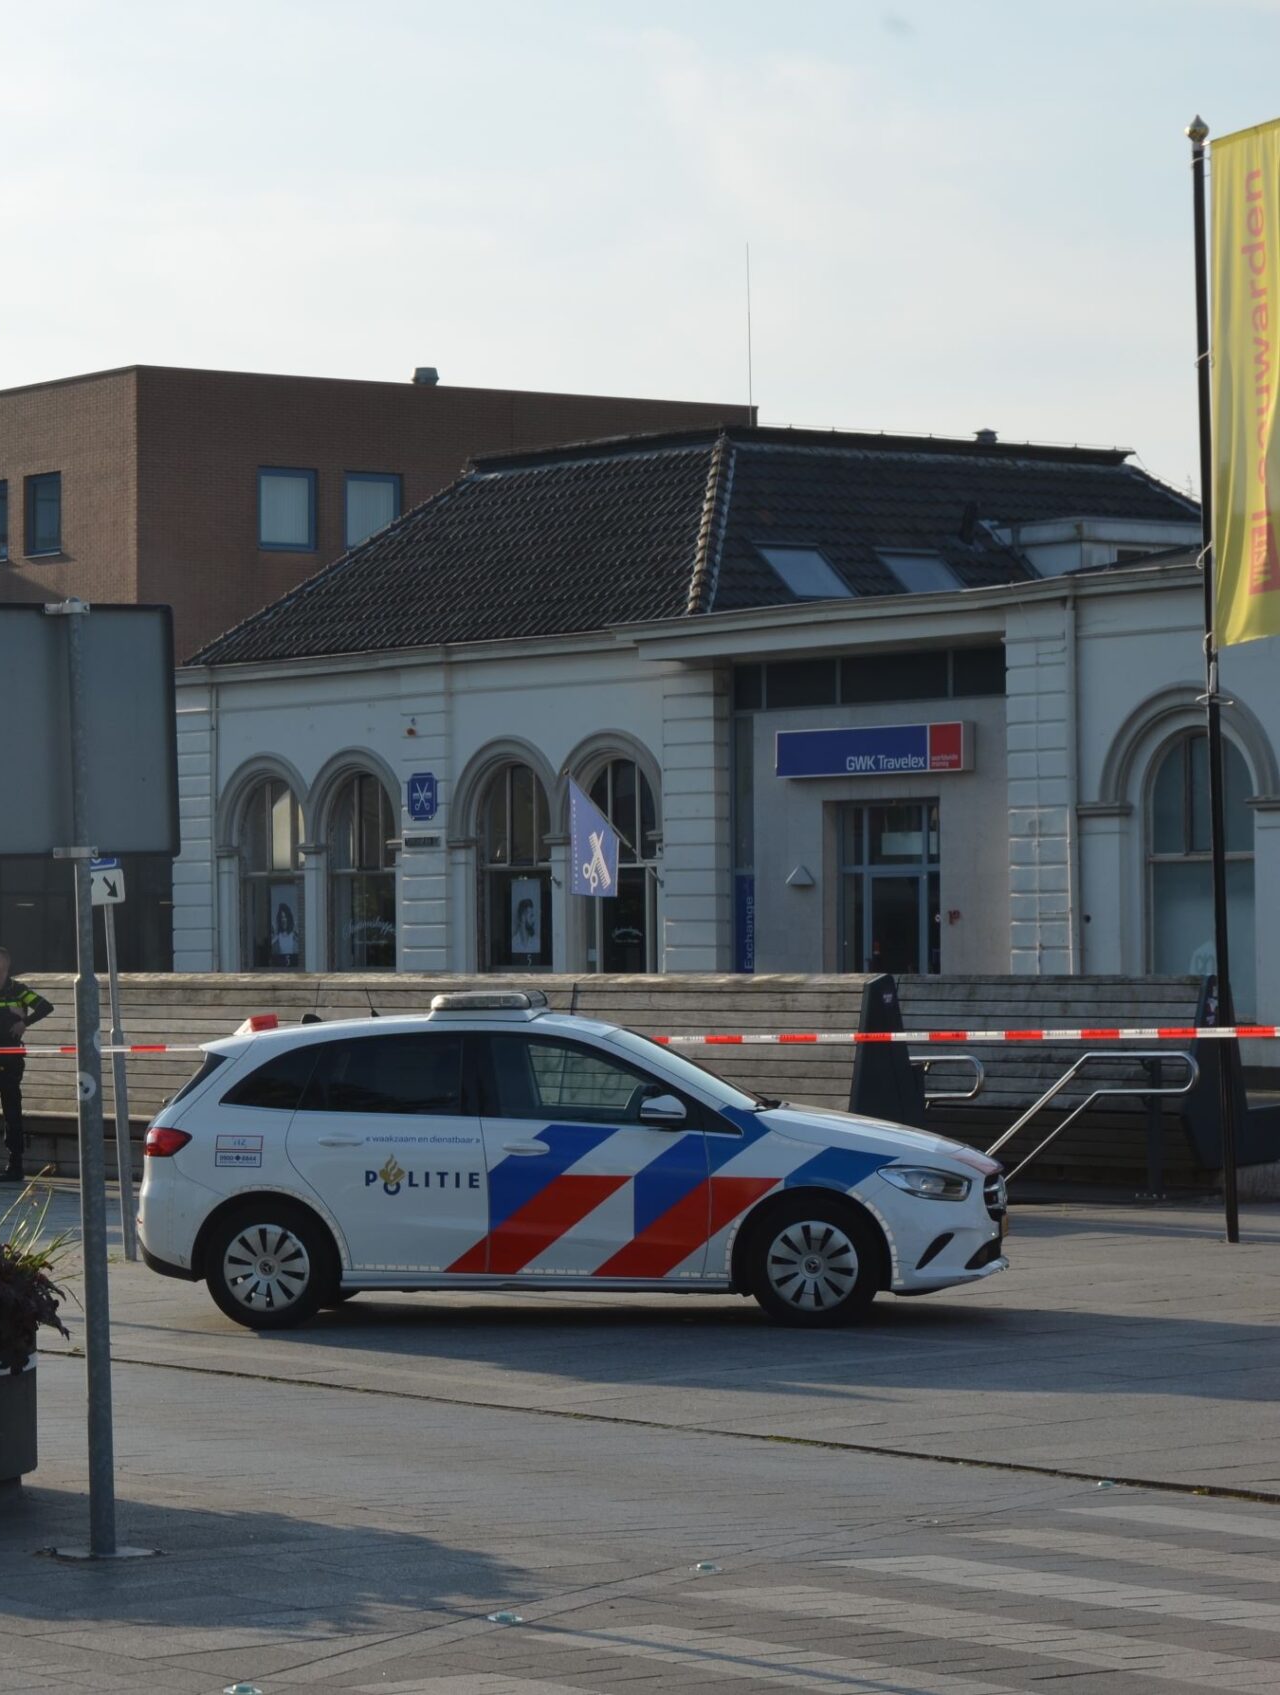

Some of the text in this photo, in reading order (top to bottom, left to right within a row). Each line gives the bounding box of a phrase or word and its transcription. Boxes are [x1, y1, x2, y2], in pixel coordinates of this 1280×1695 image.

[846, 754, 925, 771] GWK Travelex
[744, 896, 754, 969] Exchange
[372, 1135, 416, 1143] waakzaam
[429, 1135, 473, 1144] dienstbaar
[365, 1170, 480, 1196] POLITIE
